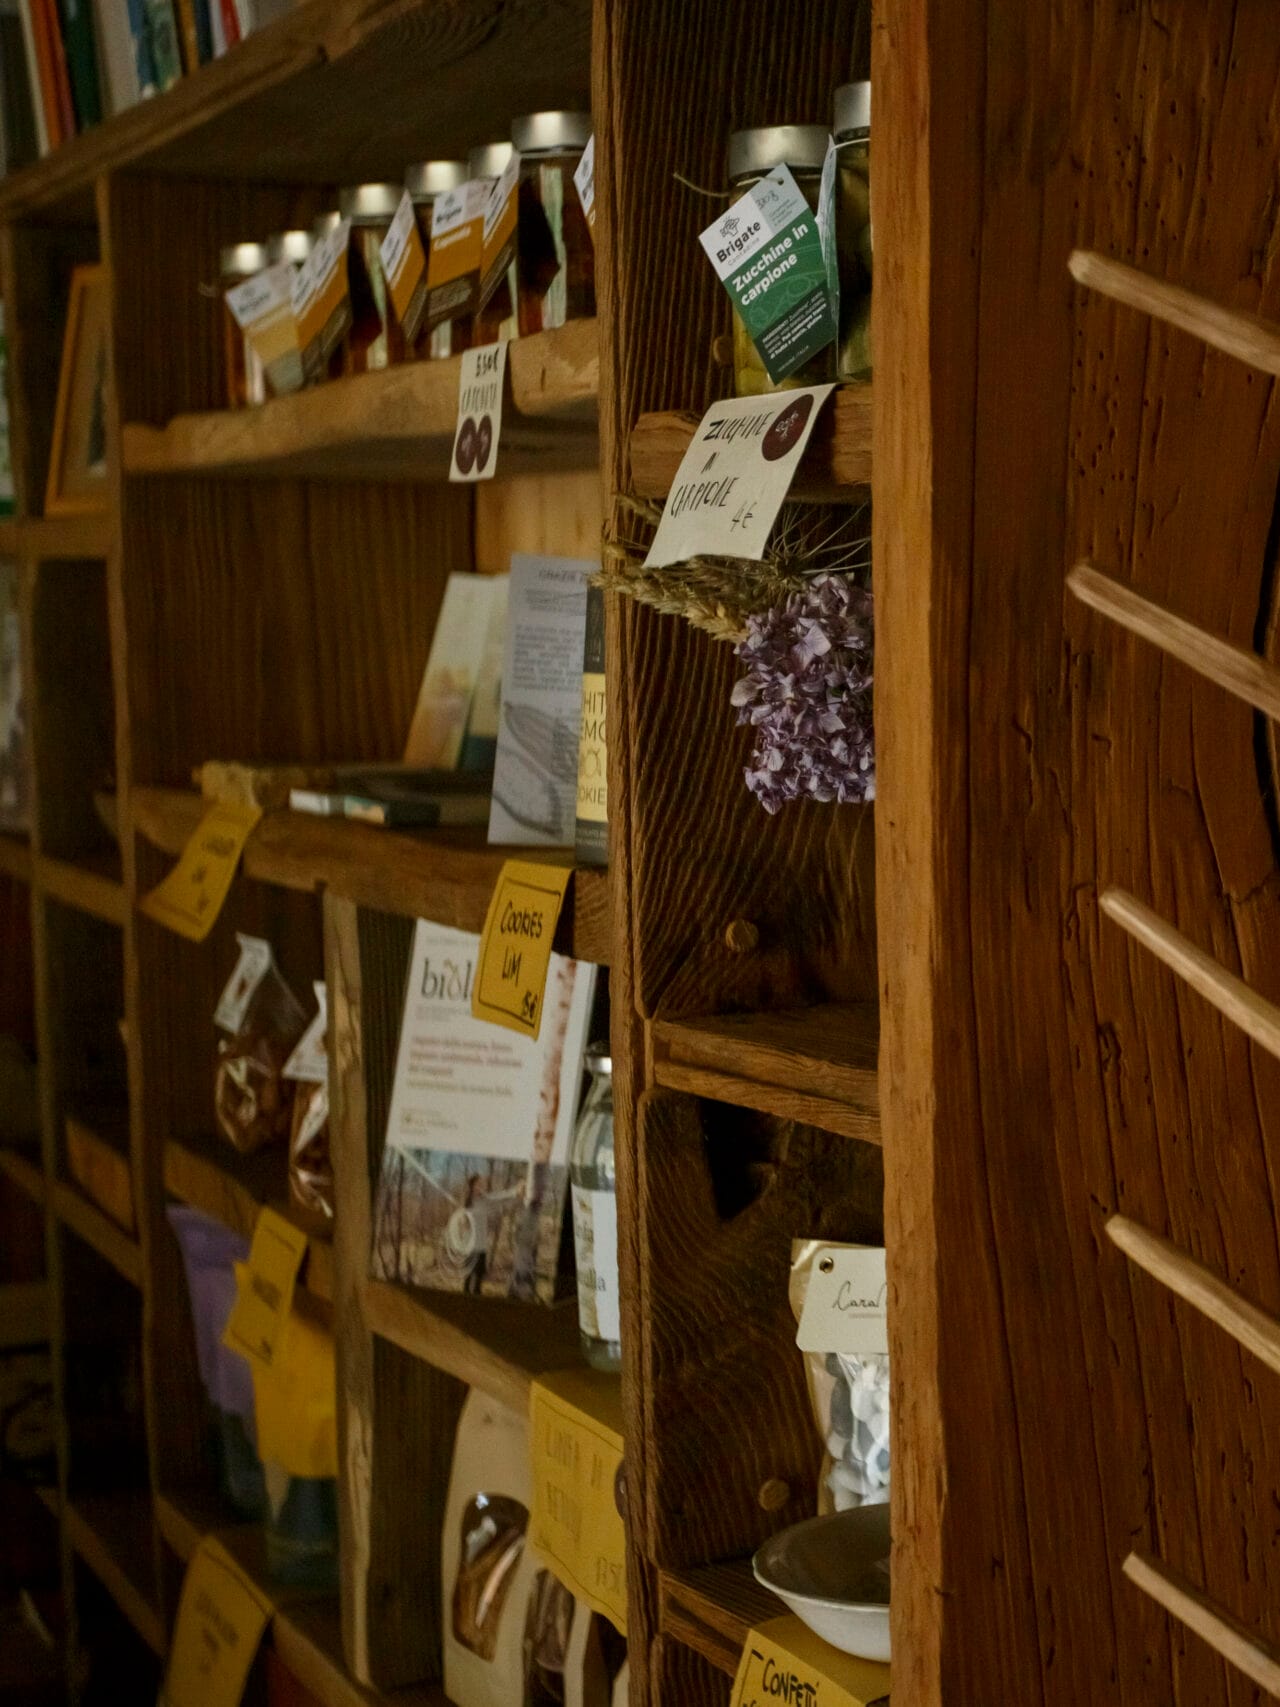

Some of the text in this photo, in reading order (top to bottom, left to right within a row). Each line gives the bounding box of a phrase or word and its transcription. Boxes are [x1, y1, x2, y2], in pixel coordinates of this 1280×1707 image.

[716, 222, 761, 262] Brigate
[732, 223, 809, 292] Zucchine in
[741, 253, 798, 306] carpione
[671, 477, 740, 518] CARPIONE
[500, 901, 544, 938] COOKIES
